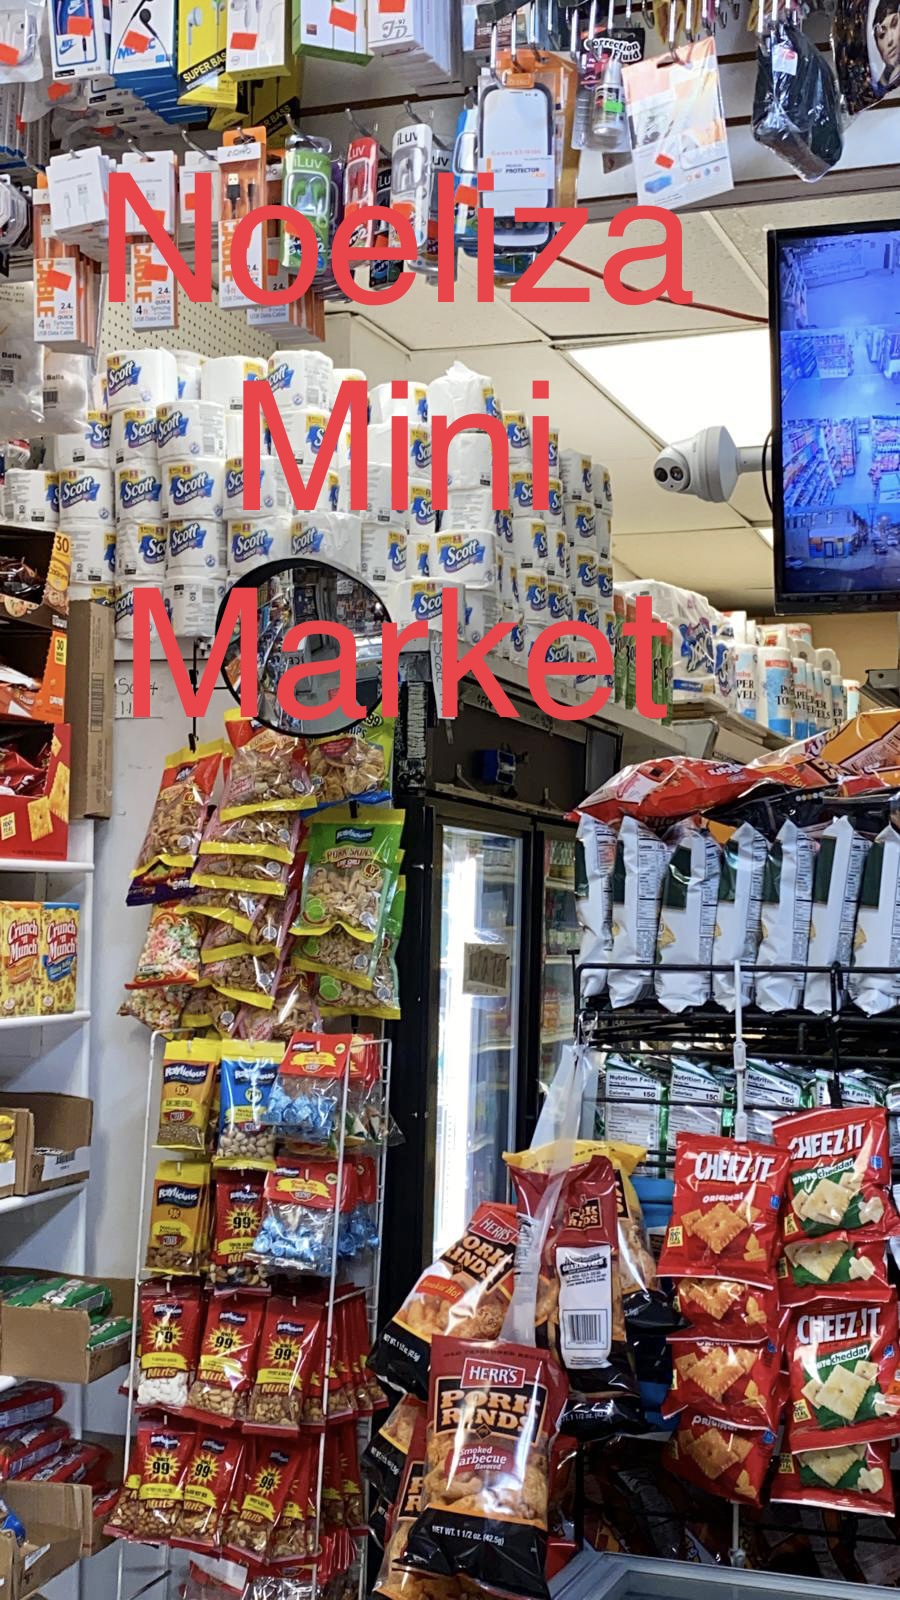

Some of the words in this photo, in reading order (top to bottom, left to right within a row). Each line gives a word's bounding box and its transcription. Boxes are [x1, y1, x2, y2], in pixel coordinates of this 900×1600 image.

[613, 49, 639, 60] Fluid
[182, 59, 211, 82] SUPER
[211, 51, 226, 70] BAS
[397, 131, 418, 146] iLuv
[293, 155, 322, 169] iLuv
[378, 174, 391, 188] iLu
[109, 360, 135, 389] Scott
[267, 363, 287, 386] cott
[158, 411, 182, 440] Scott
[62, 475, 94, 501] Scott
[123, 476, 154, 500] Scott
[175, 472, 207, 498] Scott
[55, 535, 69, 554] 30
[171, 522, 199, 549] Scott
[237, 528, 267, 553] Scott
[292, 527, 316, 549] Scott
[446, 540, 478, 566] Scott
[418, 591, 443, 612] Sco
[56, 639, 64, 651] 30
[9, 919, 39, 944] Crunch
[47, 918, 78, 943] Crunch
[9, 941, 39, 967] Munch
[47, 940, 78, 965] Munch
[164, 1065, 207, 1078] Raylicious
[609, 1074, 639, 1082] Nutrition
[640, 1076, 657, 1084] Facts
[673, 1073, 702, 1082] Nutrition
[781, 1096, 794, 1104] 150
[479, 1217, 514, 1241] HERR'S
[462, 1235, 513, 1266] ORK
[446, 1246, 494, 1281] INDS
[831, 1345, 868, 1365] cheddar
[147, 1367, 177, 1378] Nuts
[200, 1370, 229, 1383] Nuts
[469, 1365, 518, 1384] HERR'S
[262, 1383, 289, 1393] Nuts
[441, 1389, 541, 1416] PORK
[458, 1453, 507, 1467] arbecue
[146, 1499, 175, 1509] Nuts
[432, 1524, 444, 1535] NET
[444, 1526, 457, 1537] WT.
[461, 1529, 472, 1540] 1/2
[472, 1532, 482, 1541] oz.
[482, 1532, 505, 1546] (42.5g)
